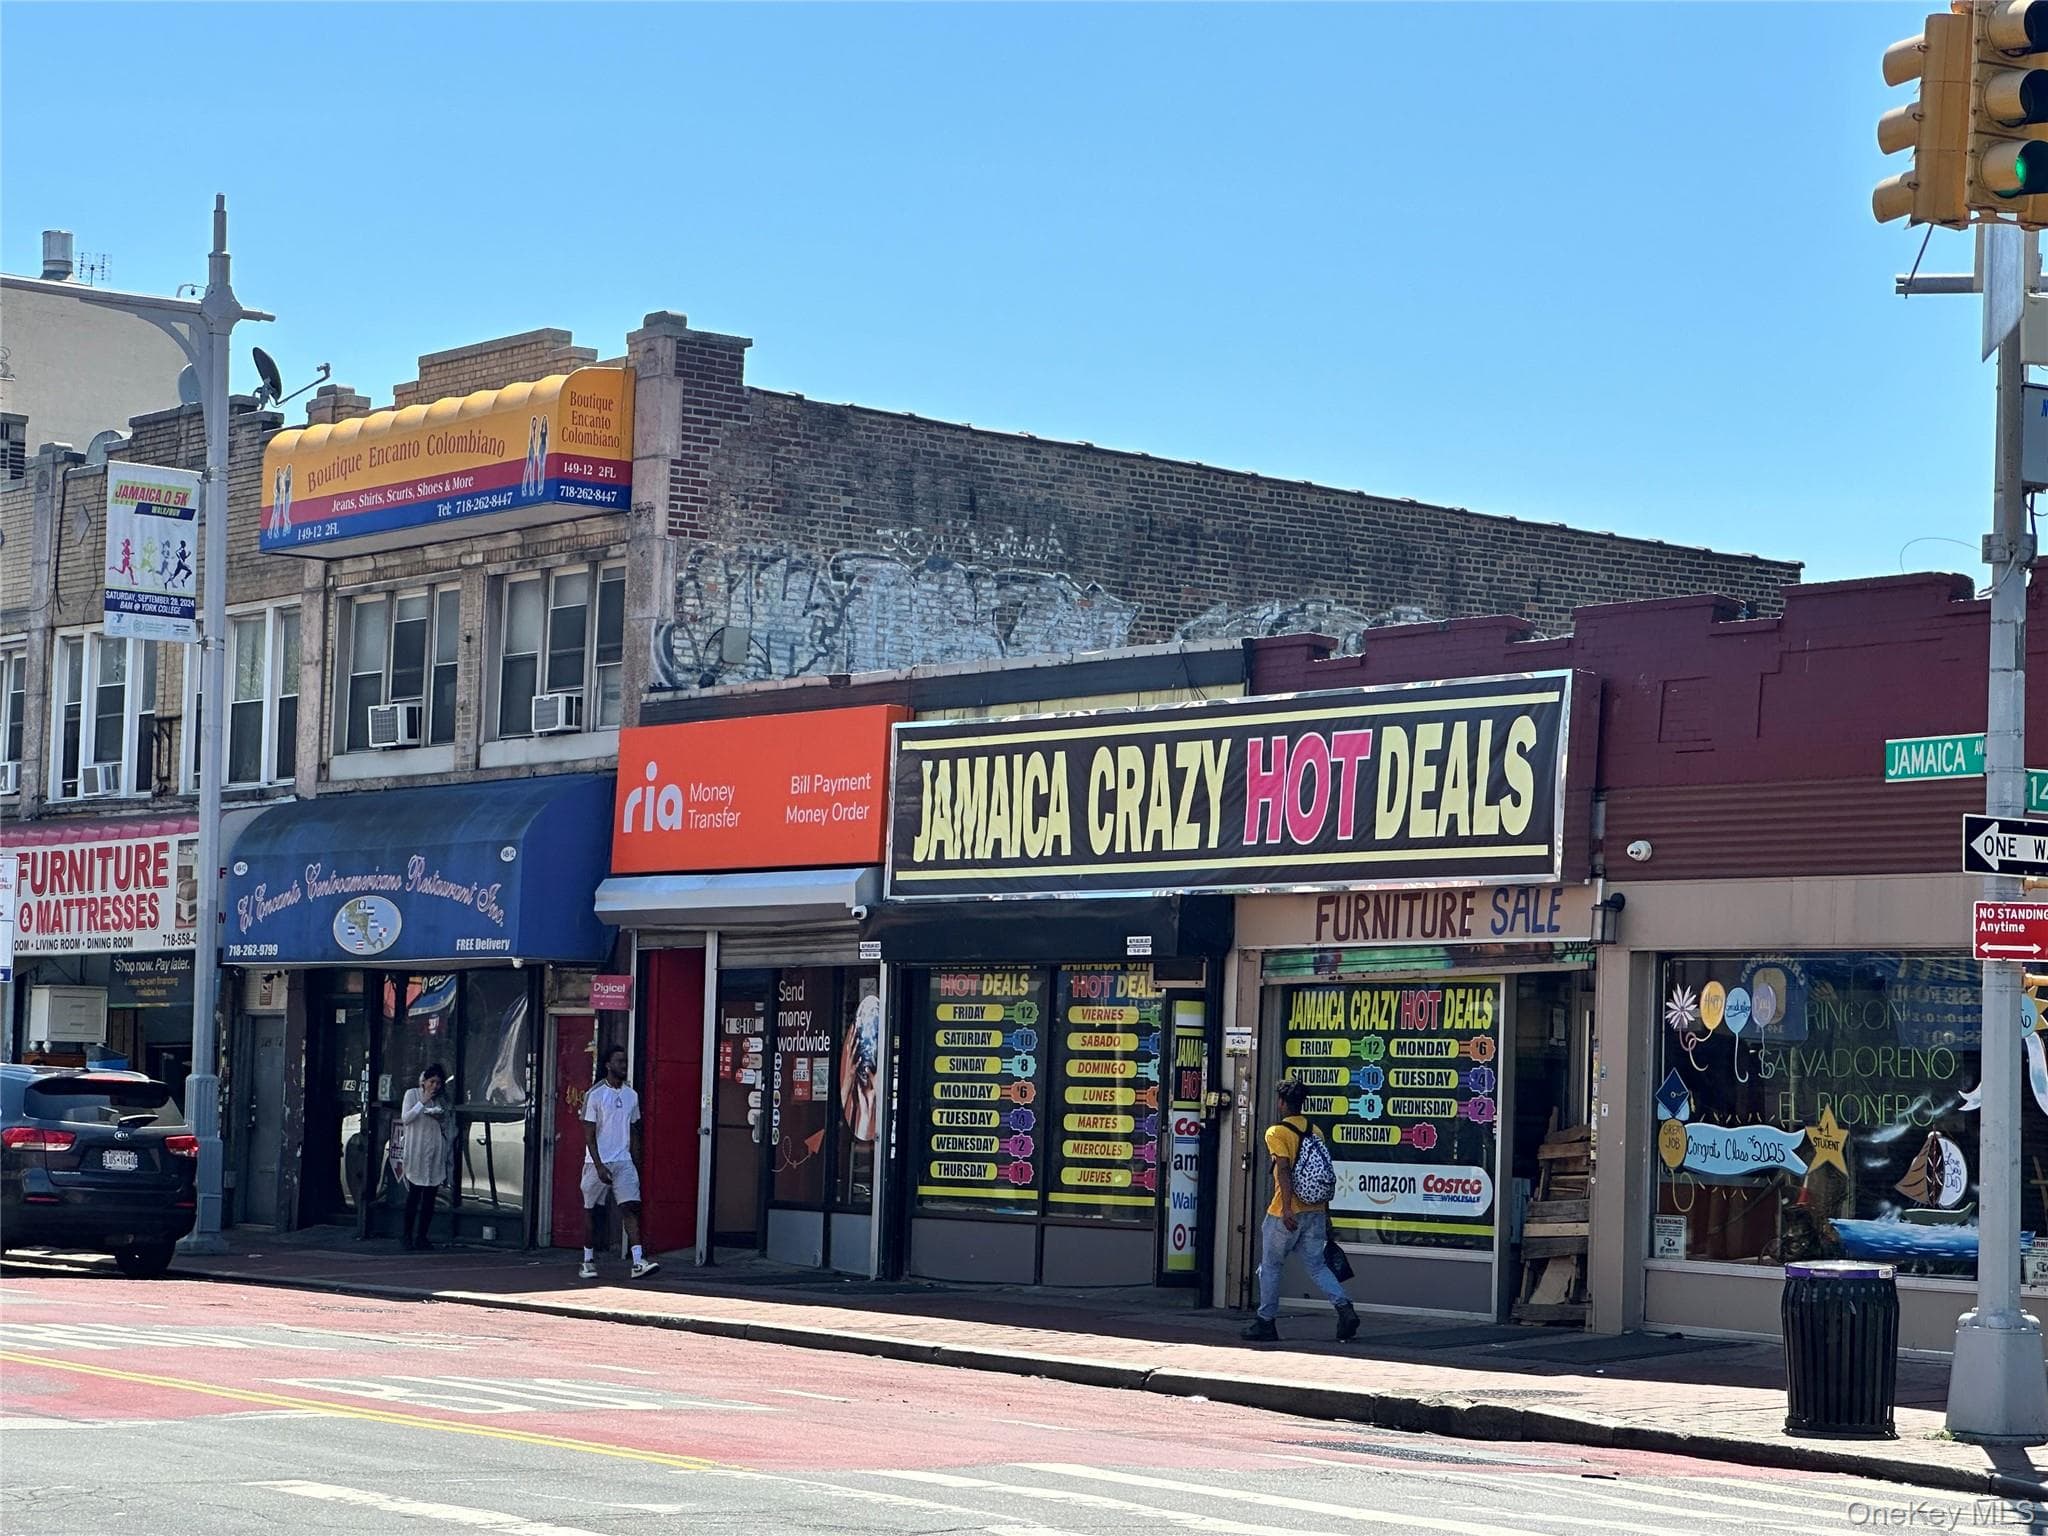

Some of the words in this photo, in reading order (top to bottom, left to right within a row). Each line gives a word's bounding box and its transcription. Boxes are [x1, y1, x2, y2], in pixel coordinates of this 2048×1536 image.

[570, 391, 613, 412] Boutique
[572, 410, 611, 430] Encanto
[561, 426, 620, 449] Colombiano
[307, 453, 363, 493] Boutique
[369, 439, 420, 468] Encanto
[426, 430, 505, 458] Colombiano
[564, 462, 593, 476] 149-12
[598, 465, 617, 479] 2FL
[115, 484, 162, 504] JAMAICA
[175, 491, 189, 507] 5K
[332, 499, 358, 513] Jeans,
[358, 492, 385, 508] Shirts,
[387, 487, 416, 503] Scurts,
[417, 481, 443, 497] Shoes
[444, 478, 451, 490] &
[452, 475, 474, 490] More
[297, 527, 322, 541] 149-12
[325, 522, 340, 536] 2FL
[134, 601, 141, 611] @
[141, 602, 158, 613] YORK
[158, 604, 182, 616] COLLEGE
[137, 592, 170, 605] SEPTEMBER
[180, 597, 195, 608] 2024
[1888, 741, 1966, 777] JAMAICA
[790, 775, 811, 795] Bill
[814, 772, 872, 797] Payment
[912, 750, 1072, 863] JAMAICA
[1088, 738, 1233, 856] CRAZY
[1242, 728, 1374, 846] HOT
[1375, 715, 1537, 840] DEALS
[623, 761, 683, 834] ria
[689, 783, 736, 805] Money
[688, 809, 742, 830] Transfer
[786, 804, 829, 825] Money
[832, 802, 870, 822] Order
[1983, 835, 2017, 858] ONE
[16, 841, 170, 897] FURNITURE
[254, 879, 302, 923] Encanto
[305, 862, 402, 902] Centroamericano
[405, 854, 478, 906] Restaurant
[35, 893, 160, 936] MATTRESSES
[1315, 890, 1477, 942] FURNITURE
[1490, 887, 1564, 937] SALE
[1979, 908, 1995, 920] NO
[1979, 920, 2026, 933] Anytime
[35, 938, 59, 951] LIVING
[60, 937, 81, 950] ROOM
[87, 937, 112, 950] DINING
[112, 936, 134, 949] ROOM
[228, 944, 279, 957] 718-262-9799
[456, 938, 475, 951] FREE
[475, 937, 511, 951] Delivery
[136, 960, 154, 972] now.
[154, 958, 171, 974] Pay
[170, 957, 191, 970] later.
[593, 982, 626, 994] Digicel
[778, 980, 805, 1002] Send
[940, 974, 980, 997] HOT
[982, 972, 1029, 996] DEALS
[1072, 975, 1114, 998] HOT
[952, 1006, 986, 1021] FRIDAY
[1081, 1008, 1124, 1021] VIERNES
[1289, 990, 1345, 1031] JAMAICA
[1350, 990, 1400, 1031] CRAZY
[1400, 990, 1442, 1031] HOT
[1443, 988, 1494, 1031] DEALS
[1804, 999, 1906, 1032] RINCON
[778, 1009, 813, 1032] money
[777, 1029, 831, 1052] worldwide
[943, 1031, 992, 1046] SATURDAY
[1080, 1035, 1121, 1048] SABADO
[1300, 1039, 1334, 1056] FRIDAY
[1396, 1040, 1452, 1057] MONDAY
[949, 1058, 987, 1072] SUNDAY
[1077, 1061, 1126, 1075] DOMINGO
[1291, 1069, 1340, 1085] SATURDAY
[1394, 1070, 1451, 1088] TUESDAY
[940, 1084, 994, 1099] MONDAY
[1082, 1089, 1116, 1102] LUNES
[1300, 1096, 1334, 1113] UNDAY
[1392, 1098, 1453, 1116] WEDNESDAY
[1778, 1092, 1803, 1124] EL
[1817, 1092, 1935, 1127] PIONERO
[938, 1110, 994, 1126] TUESDAY
[1077, 1116, 1118, 1130] MARTES
[1340, 1126, 1392, 1143] THURSDAY
[1665, 1136, 1681, 1150] JOB
[936, 1136, 995, 1152] WEDNESDAY
[1072, 1143, 1122, 1157] MIERCOLES
[1725, 1138, 1749, 1162] Class
[1751, 1141, 1786, 1163] 2025
[1812, 1136, 1841, 1151] STUDENT
[937, 1162, 989, 1178] THURSDAY
[1076, 1171, 1112, 1184] JUEVES
[1358, 1174, 1417, 1195] amazon
[1423, 1173, 1482, 1195] COSTCO
